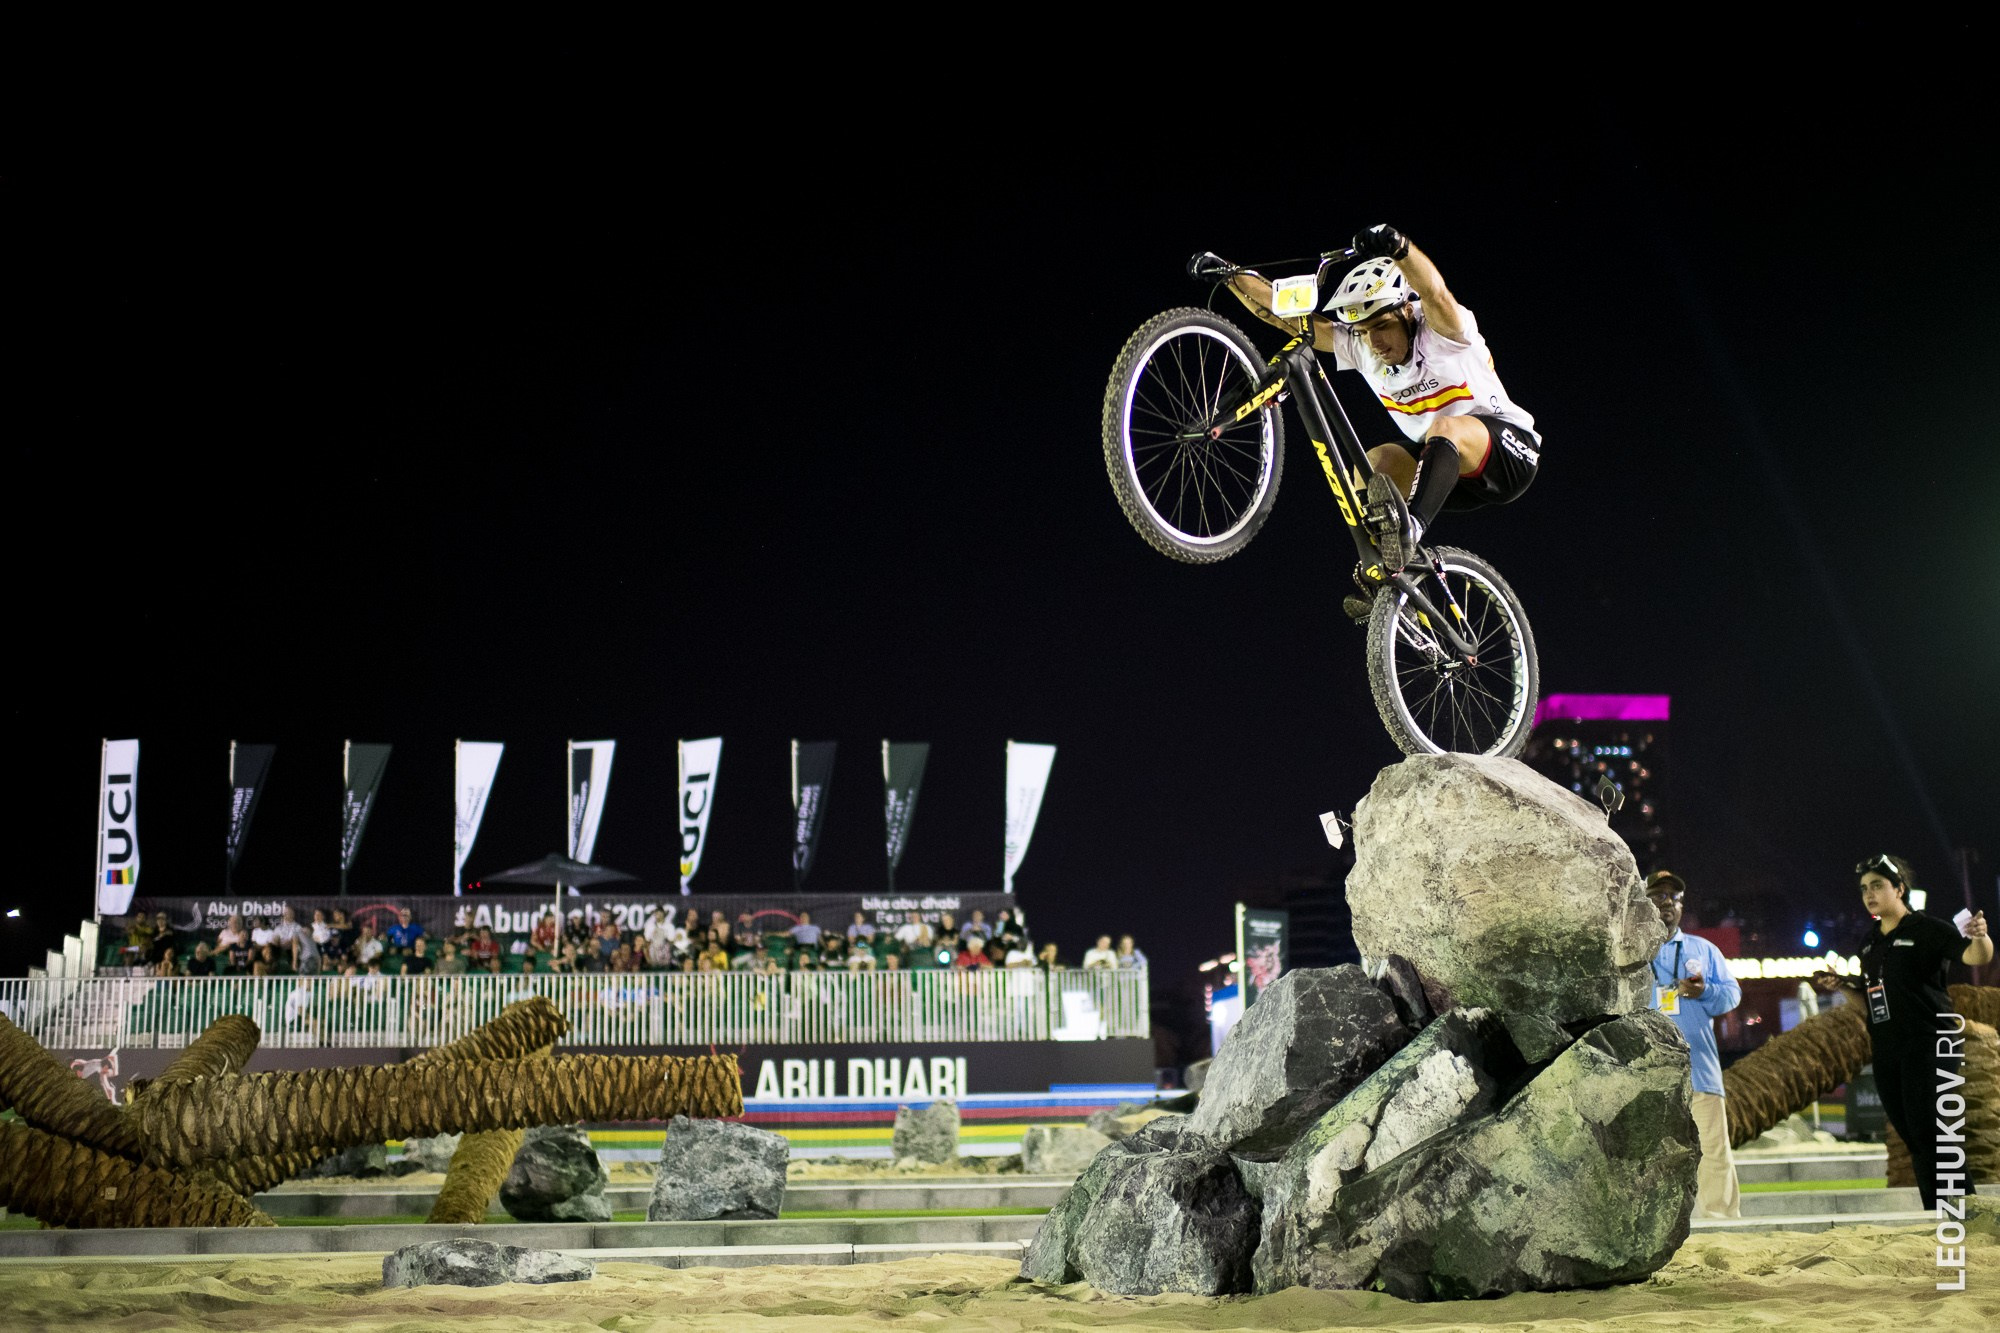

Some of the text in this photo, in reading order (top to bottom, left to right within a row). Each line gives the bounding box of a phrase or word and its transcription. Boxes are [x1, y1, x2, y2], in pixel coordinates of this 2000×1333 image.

[1236, 378, 1284, 421] CLEAN
[108, 774, 132, 863] UCI
[682, 773, 710, 858] UCI
[207, 901, 287, 916] Abu Dhabi
[862, 895, 960, 910] bike abu dhabi
[755, 1057, 967, 1099] ABU DHABI
